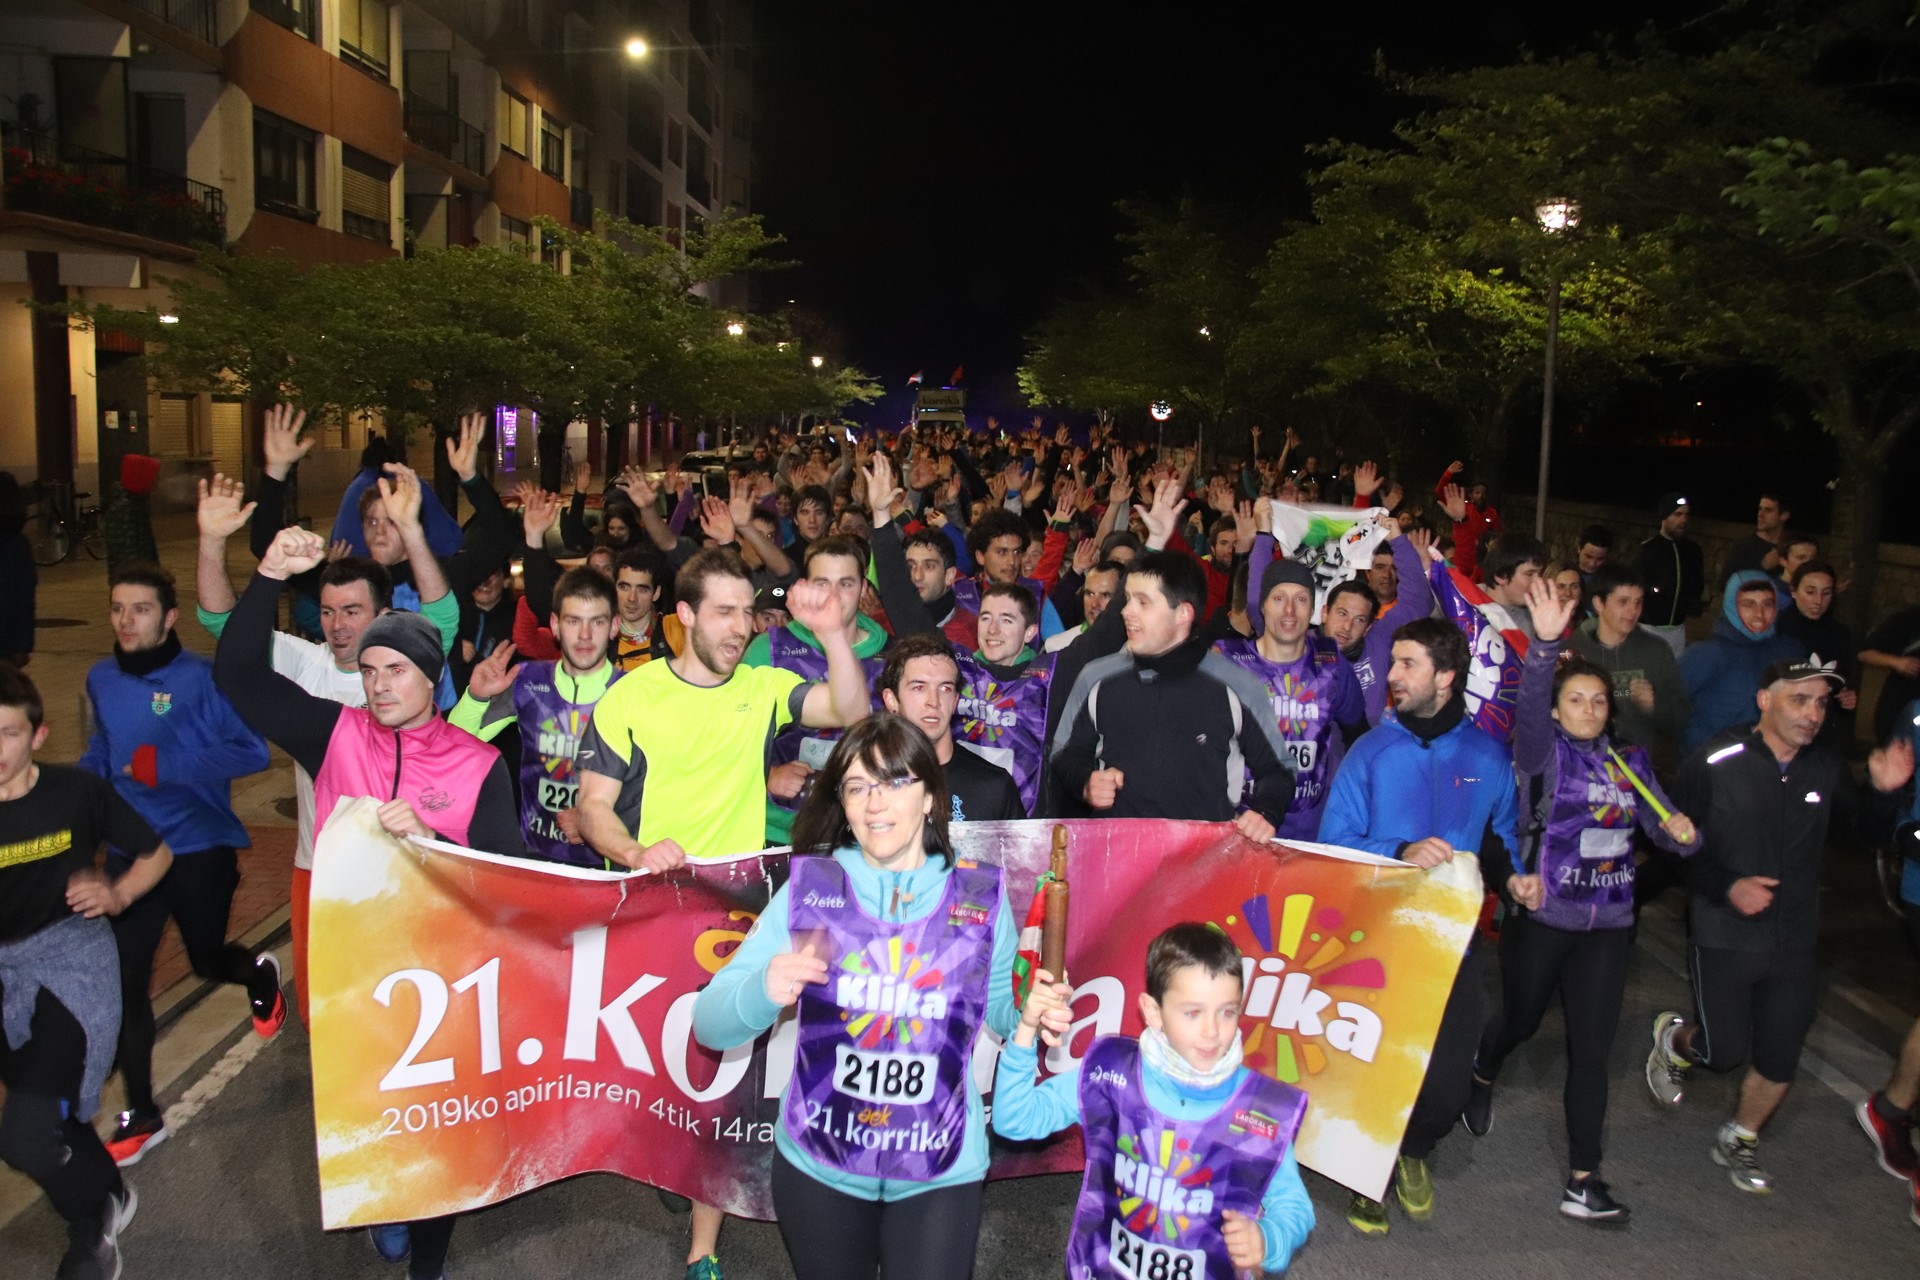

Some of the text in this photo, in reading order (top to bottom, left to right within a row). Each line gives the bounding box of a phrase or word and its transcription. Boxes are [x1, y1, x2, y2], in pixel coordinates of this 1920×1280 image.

[532, 683, 550, 693] eitb
[957, 698, 1017, 728] Klika
[1270, 694, 1319, 720] lika
[538, 732, 580, 763] Kli
[818, 893, 846, 909] eitb
[836, 972, 948, 1020] Klika
[841, 1053, 926, 1099] 2188
[1102, 1071, 1128, 1088] eitb
[381, 1094, 499, 1137] 2019ko
[504, 1074, 642, 1116] apirilaren
[648, 1097, 701, 1136] 4tik
[857, 1104, 893, 1128] aek
[1235, 1110, 1267, 1131] LABORAL
[844, 1111, 951, 1152] korrika
[1113, 1152, 1215, 1215] Klika
[1116, 1229, 1194, 1280] 2188
